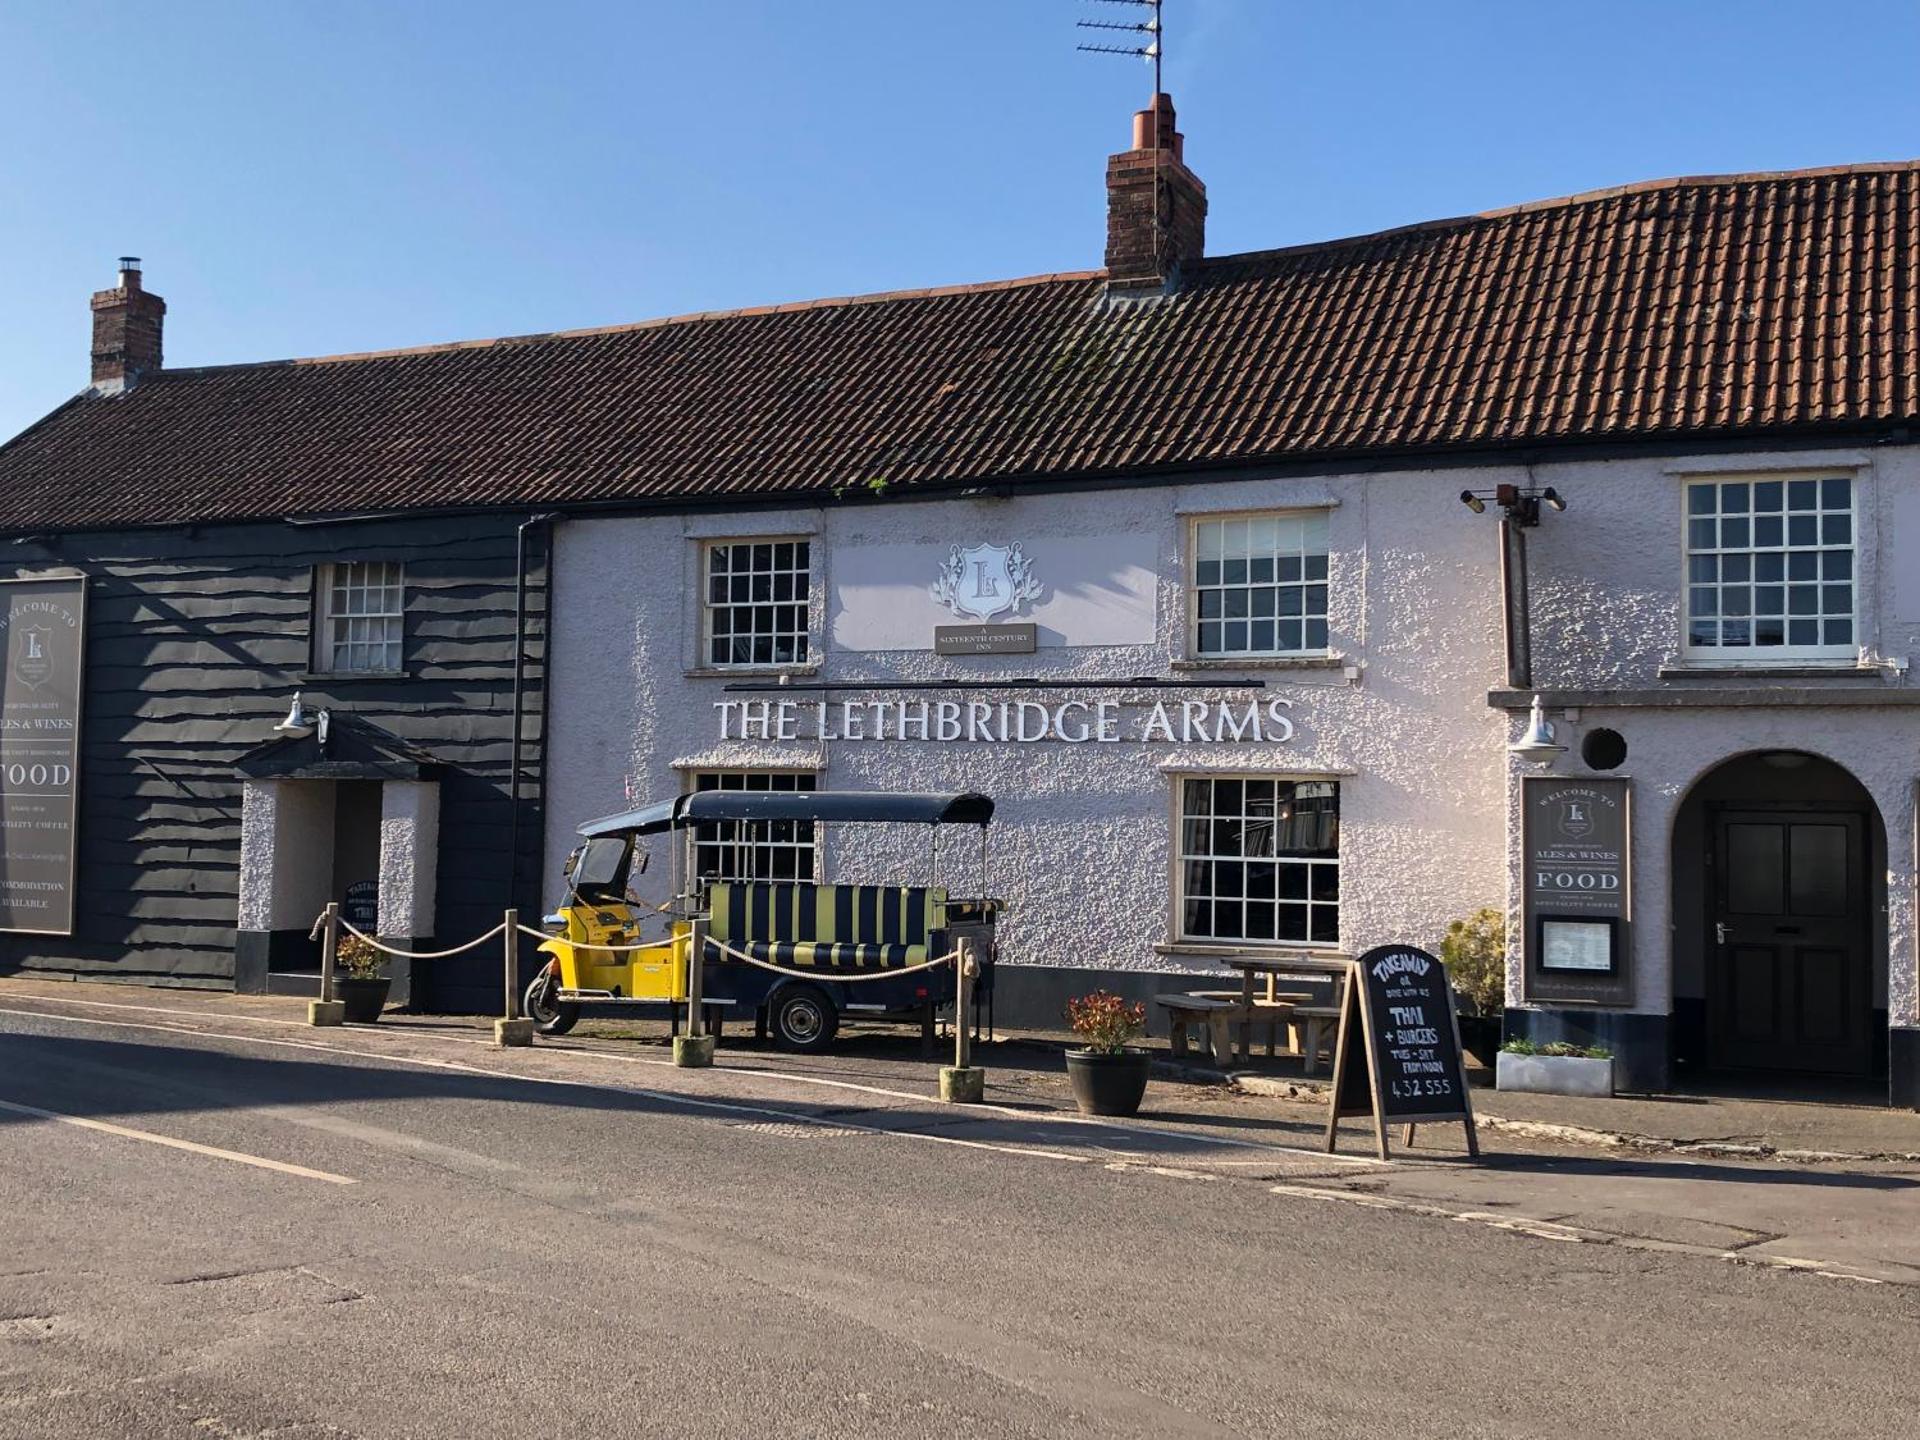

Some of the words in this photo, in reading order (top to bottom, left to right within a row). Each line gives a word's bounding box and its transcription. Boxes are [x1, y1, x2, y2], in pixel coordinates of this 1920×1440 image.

[61, 609, 76, 627] TO
[988, 633, 1028, 642] CENTURY
[34, 718, 73, 729] WINES
[713, 701, 797, 740] THE
[818, 700, 1121, 742] LETHBRIDGE
[1142, 699, 1294, 742] ARMS
[1540, 788, 1597, 807] WELCOME
[1601, 794, 1616, 808] TO
[1536, 850, 1565, 859] ALES
[1566, 850, 1577, 859] &
[1579, 851, 1619, 860] WINES
[1535, 872, 1619, 889] FOOD
[1372, 953, 1431, 982] TAKEAWAY
[1388, 1006, 1425, 1026] THAI
[1385, 1031, 1394, 1042] +
[1396, 1027, 1439, 1045] BURGERS
[1402, 1061, 1423, 1074] FROM
[1421, 1061, 1445, 1074] NOON
[1392, 1079, 1422, 1098] 432
[1425, 1079, 1452, 1096] 555
